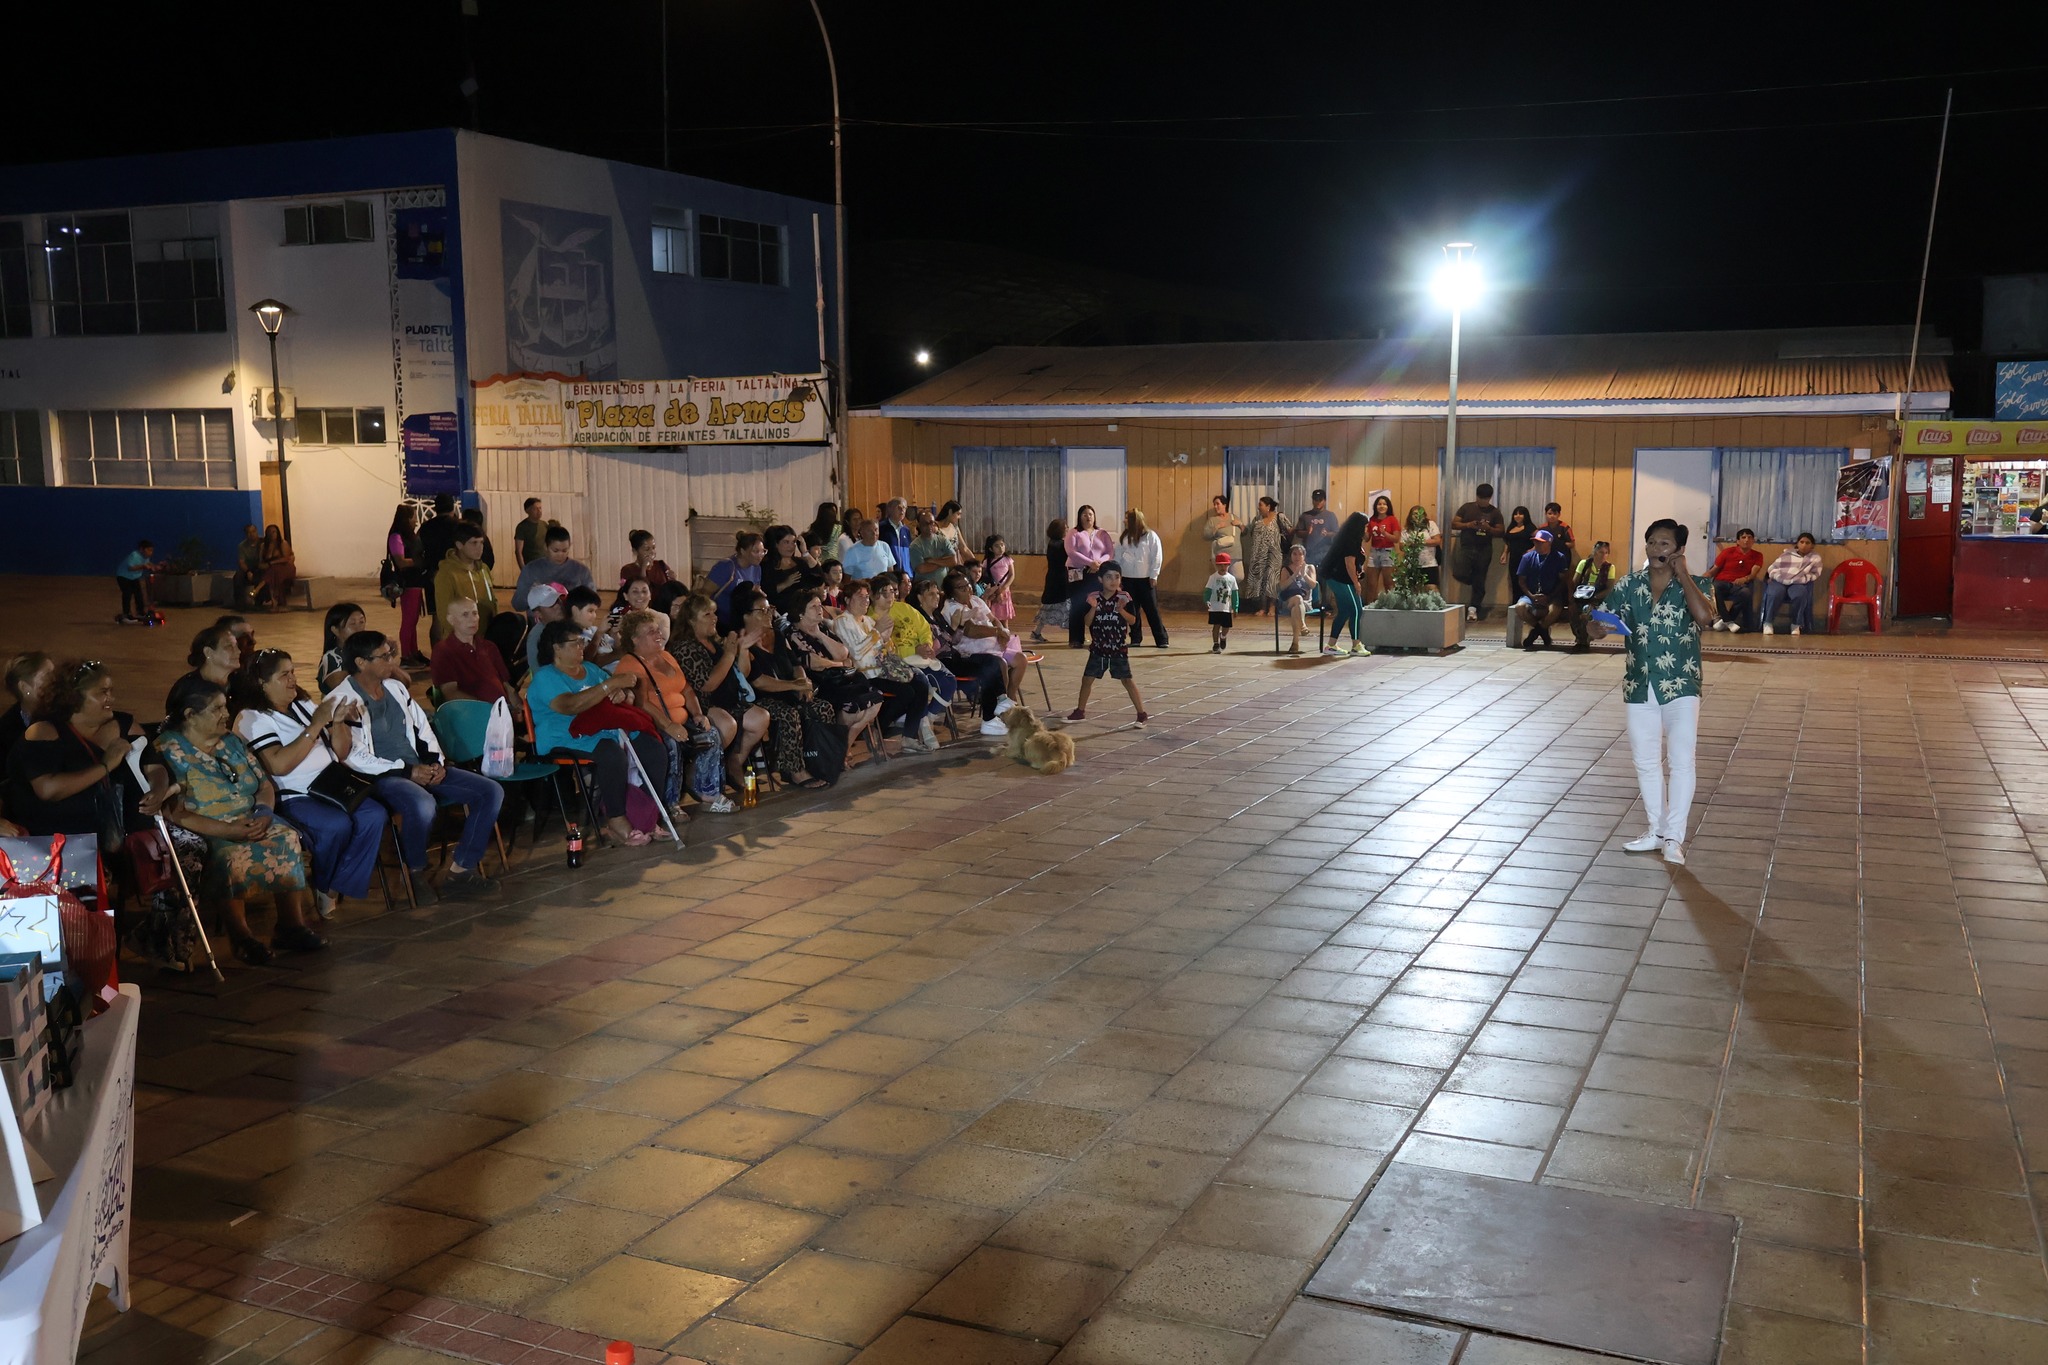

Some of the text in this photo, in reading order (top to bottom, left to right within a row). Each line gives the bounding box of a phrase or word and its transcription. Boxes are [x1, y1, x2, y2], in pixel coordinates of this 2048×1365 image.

[574, 383, 645, 395] BIENVENDOS
[655, 383, 661, 394] A
[670, 383, 684, 393] LA
[694, 381, 726, 392] FERIA
[664, 398, 700, 427] de
[639, 432, 651, 441] DE
[658, 430, 716, 441] FERIANTES
[723, 427, 790, 440] TALTALINOS
